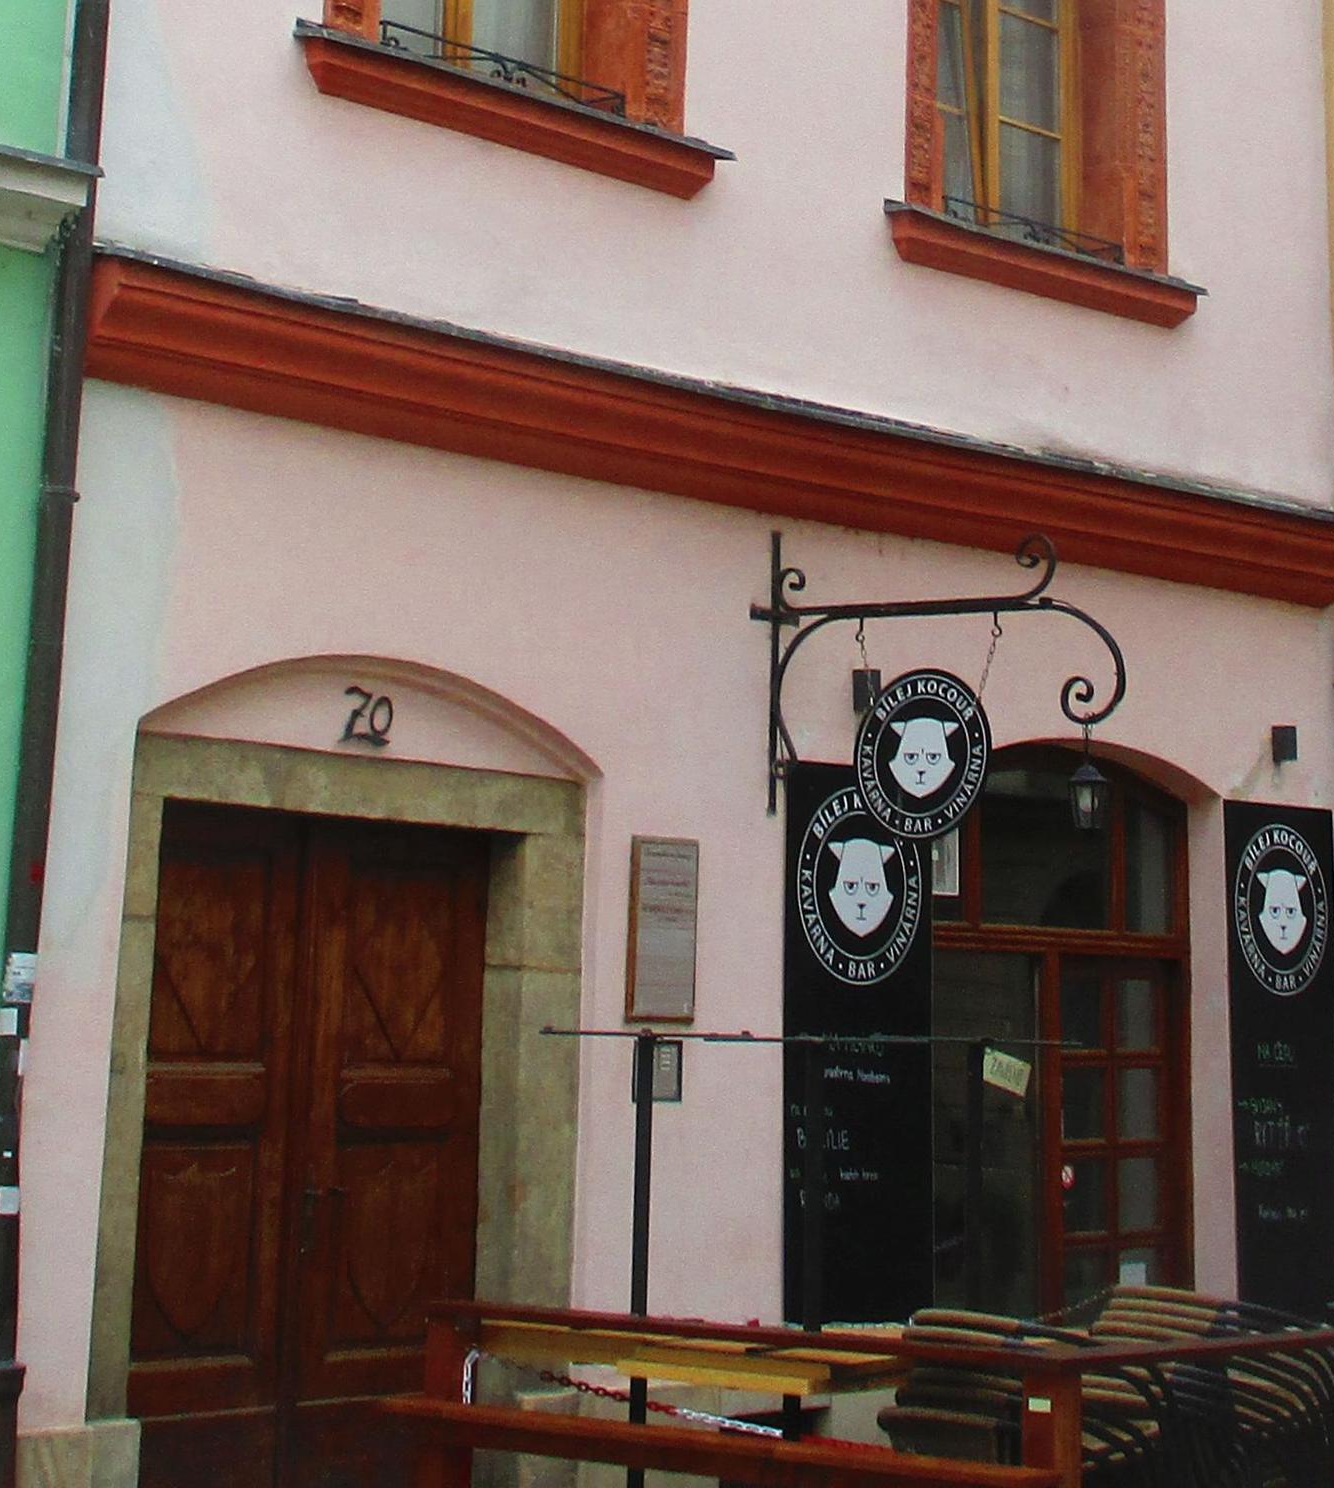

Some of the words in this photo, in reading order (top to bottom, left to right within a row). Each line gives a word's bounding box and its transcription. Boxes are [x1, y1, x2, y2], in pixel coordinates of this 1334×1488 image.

[336, 685, 394, 747] 70
[874, 683, 913, 723] BÍLEJ
[916, 679, 975, 721] KOCOUR
[860, 744, 892, 822] KAVÁRNA
[903, 817, 934, 833] BAR
[943, 743, 984, 820] VINÁRNA
[812, 793, 849, 840] BÍLEJ
[1272, 828, 1318, 876] KOCOUR
[800, 868, 835, 967] KAVÁRNA
[847, 961, 877, 980] BAR
[884, 874, 919, 963] VINÁRNA
[1274, 974, 1298, 992] BAR
